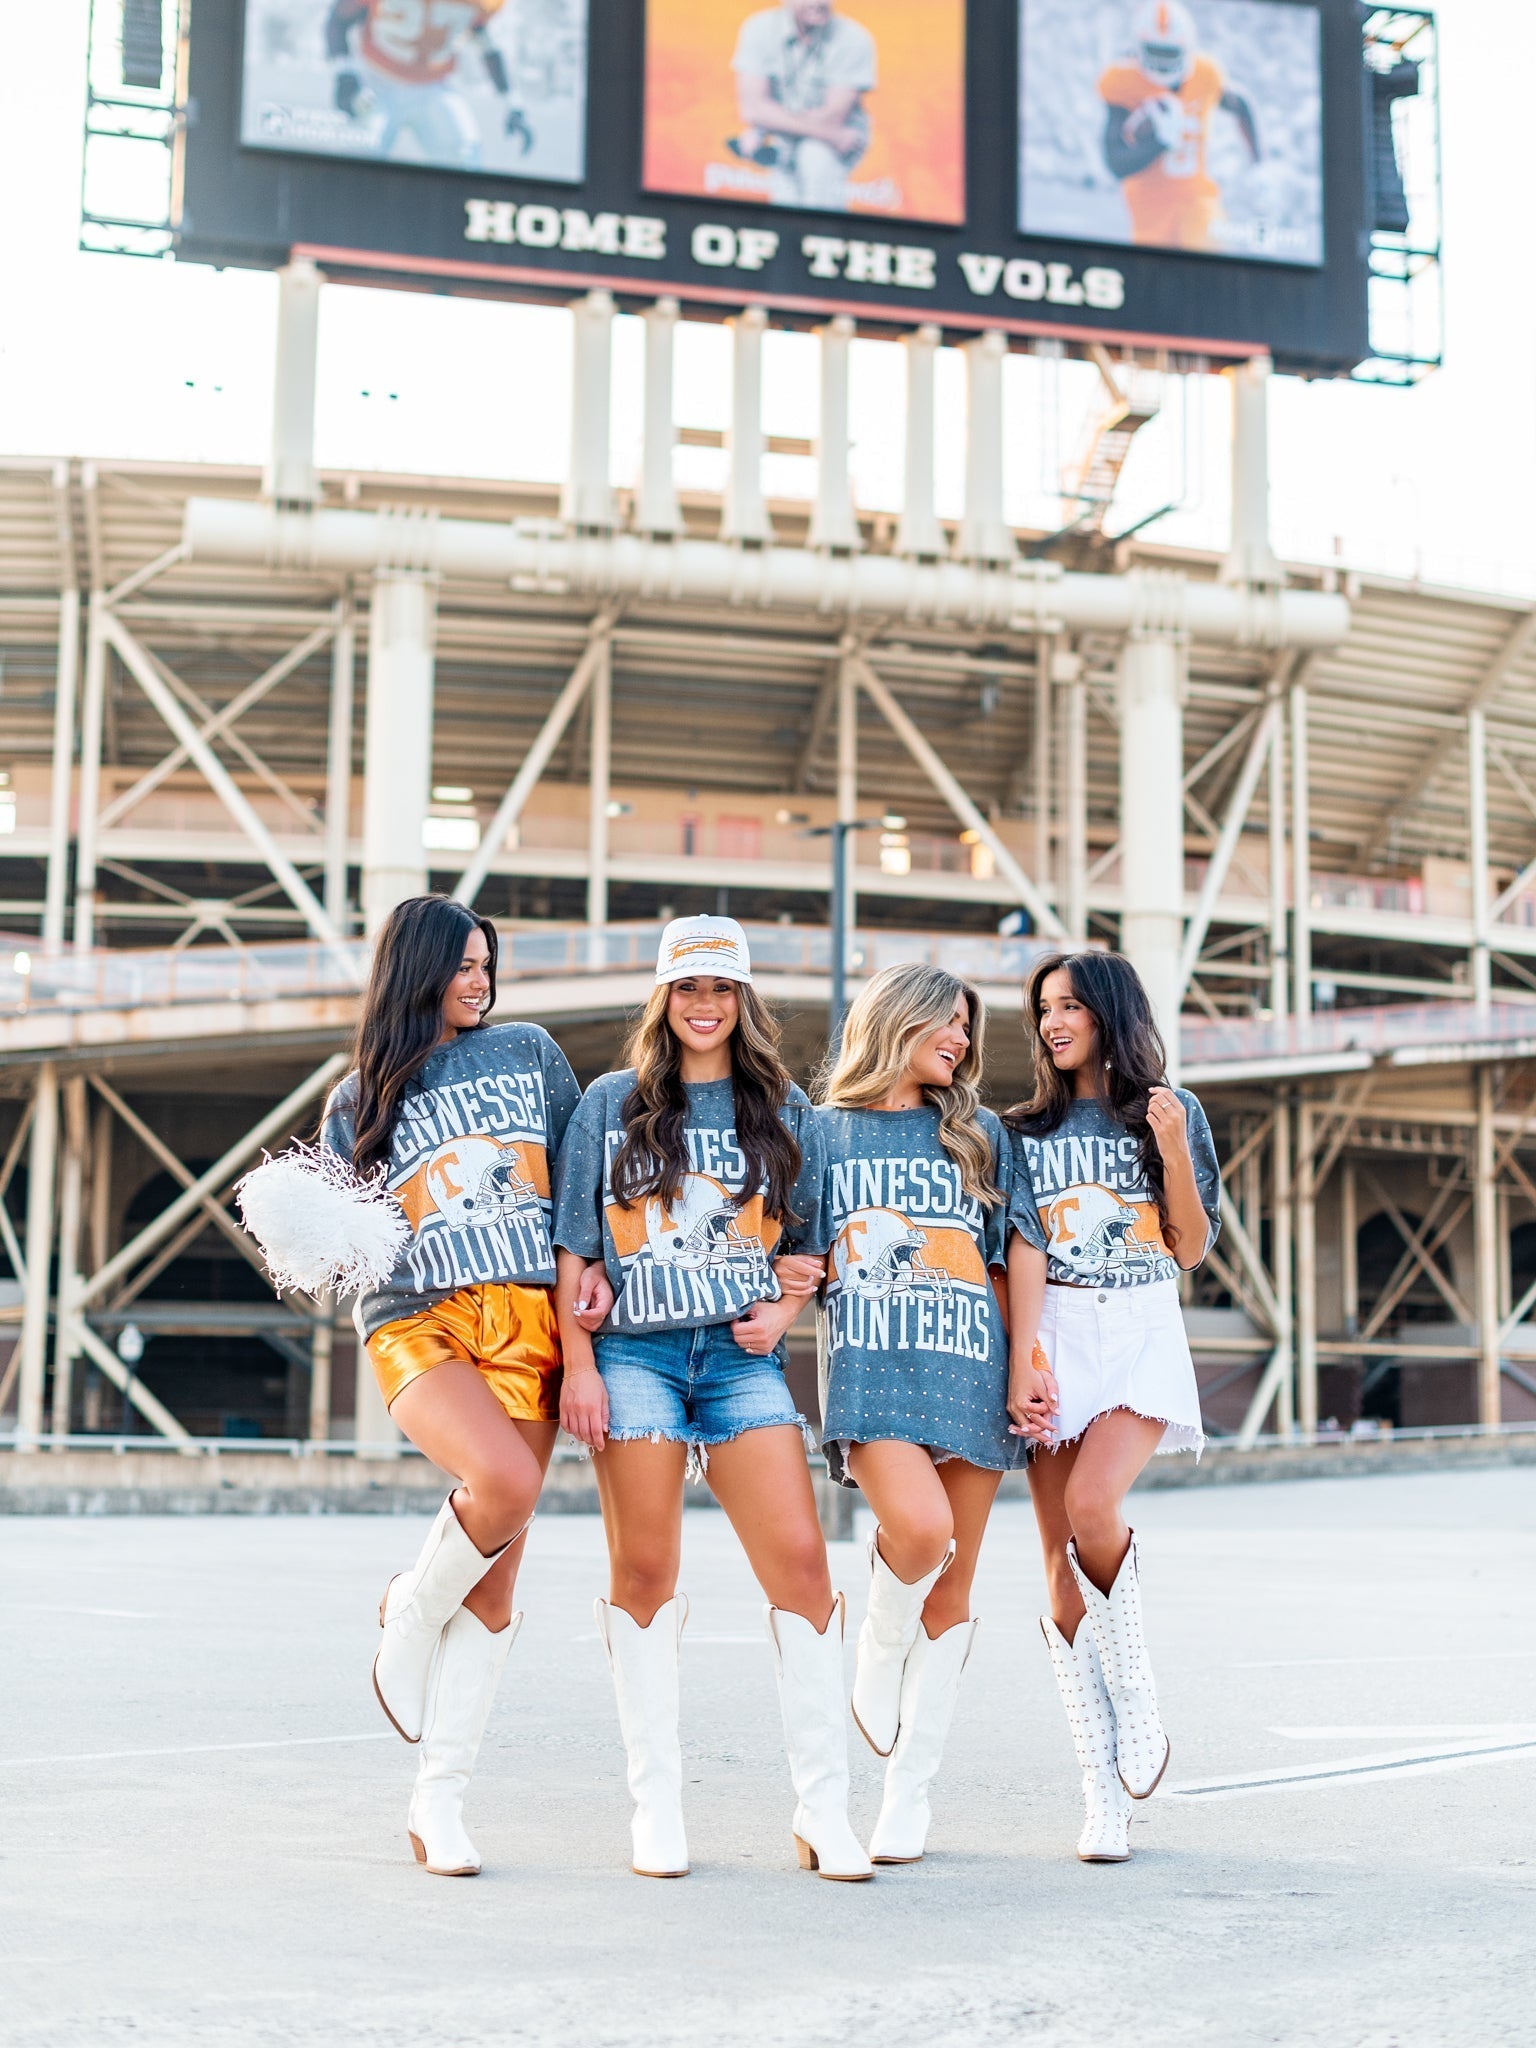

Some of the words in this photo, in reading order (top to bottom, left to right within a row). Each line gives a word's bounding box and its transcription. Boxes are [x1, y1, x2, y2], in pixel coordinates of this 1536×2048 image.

[464, 199, 667, 260] HOME
[691, 223, 779, 271] OF
[801, 235, 937, 290] THE
[957, 252, 1125, 310] VOLS
[387, 1070, 547, 1175] ENNESSE
[429, 1151, 465, 1201] T
[1022, 1135, 1148, 1195] ENNES
[837, 1220, 868, 1265] T
[1049, 1197, 1081, 1244] T
[406, 1213, 556, 1294] VOLUNTE
